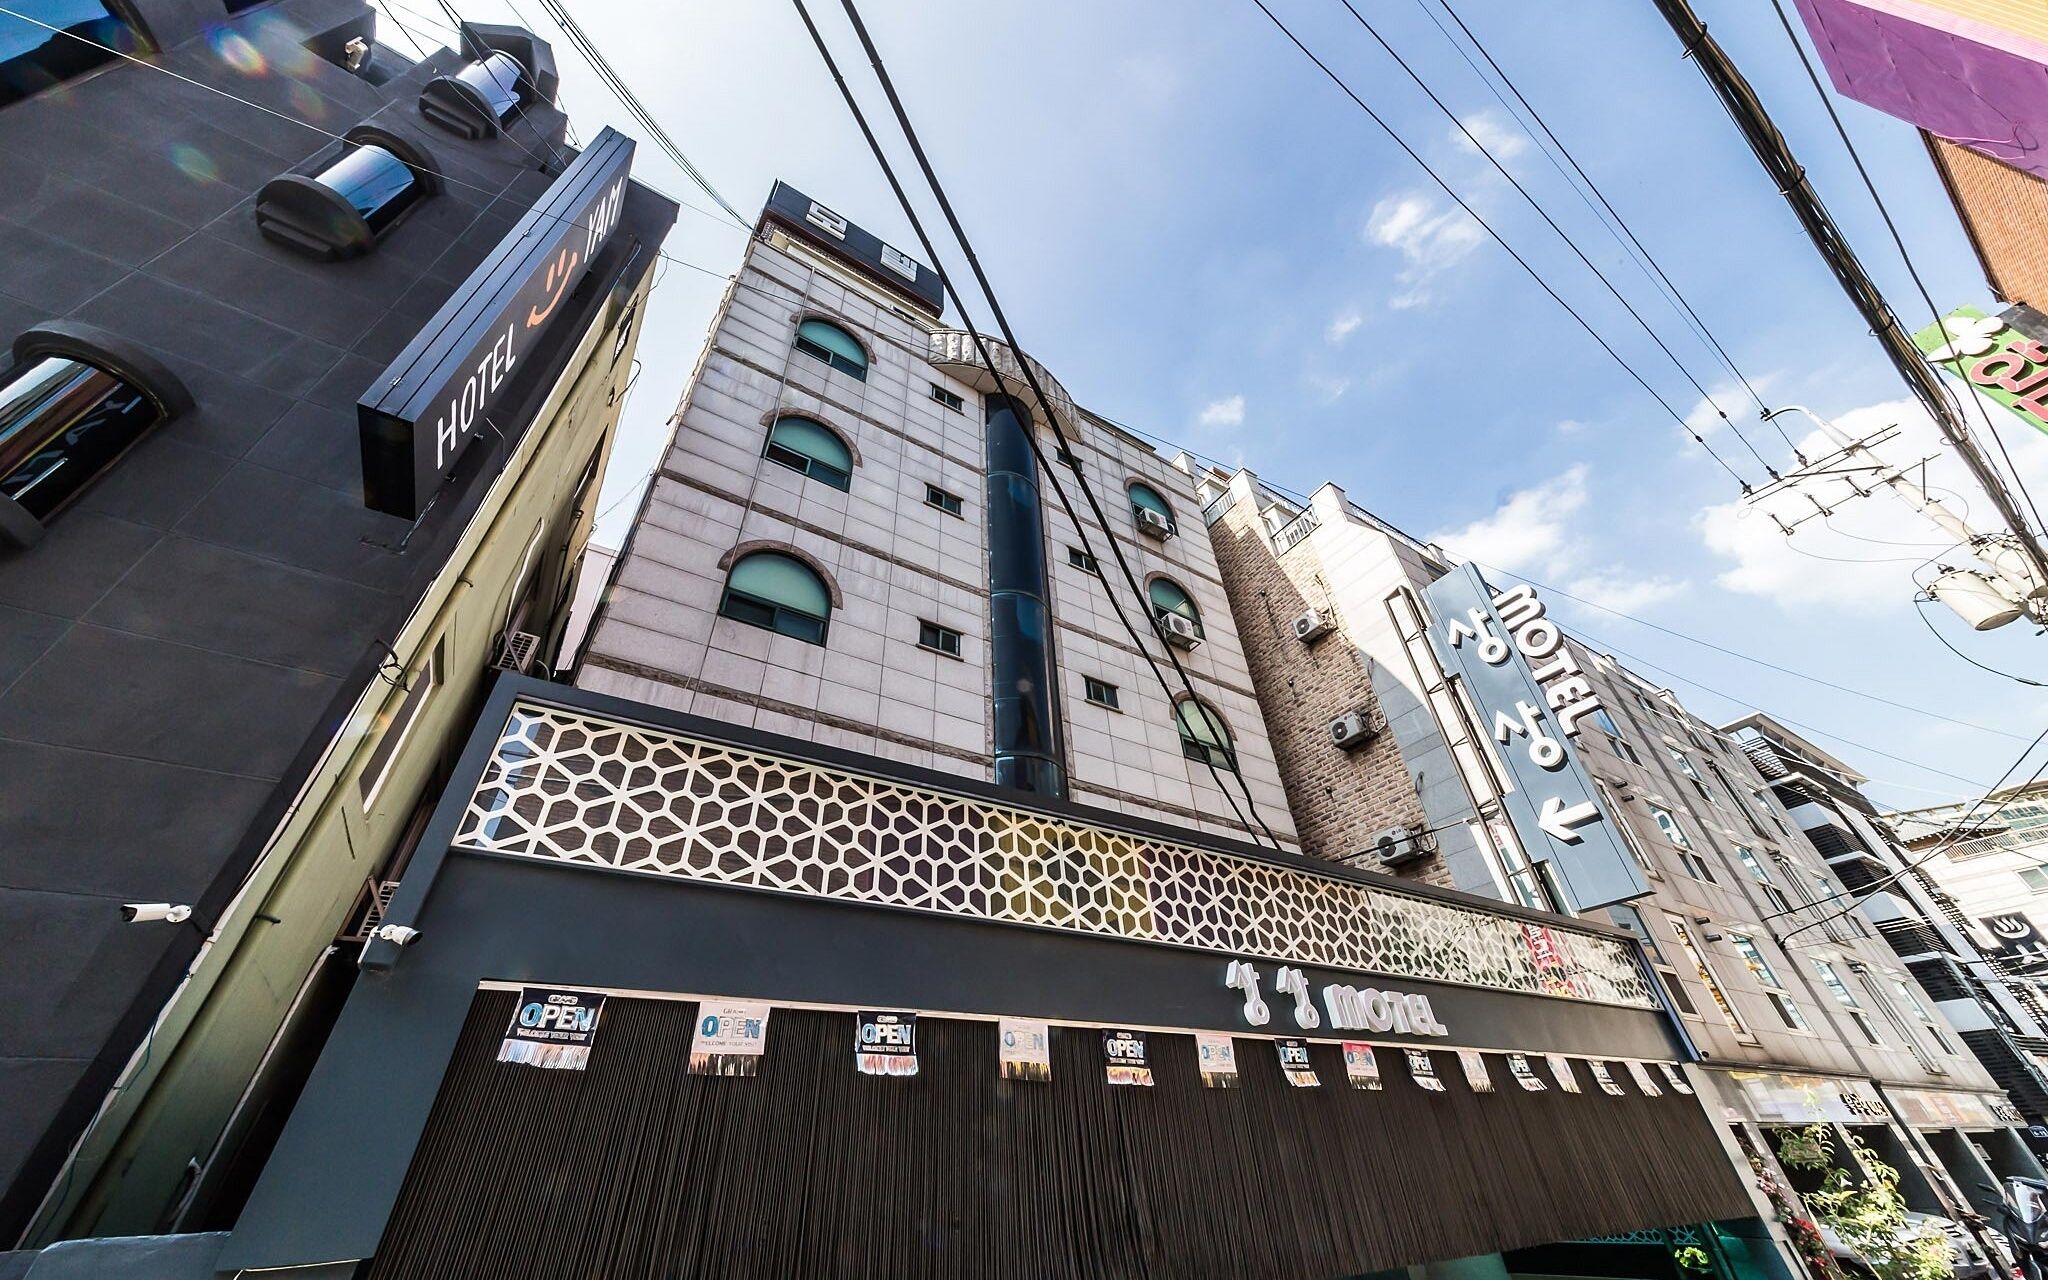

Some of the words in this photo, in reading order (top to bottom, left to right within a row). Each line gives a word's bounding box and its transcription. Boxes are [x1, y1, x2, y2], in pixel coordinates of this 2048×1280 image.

[436, 323, 516, 470] HOTEL
[583, 176, 624, 263] YAM
[1448, 606, 1566, 769] 상상
[1225, 959, 1320, 1030] 상상
[520, 1002, 596, 1031] OPEN
[701, 1015, 761, 1039] OPEN
[862, 1023, 911, 1045] OPEN
[1004, 1031, 1044, 1050] OPEN
[1107, 1038, 1144, 1058] OPEN
[1280, 1046, 1309, 1063] OPEN
